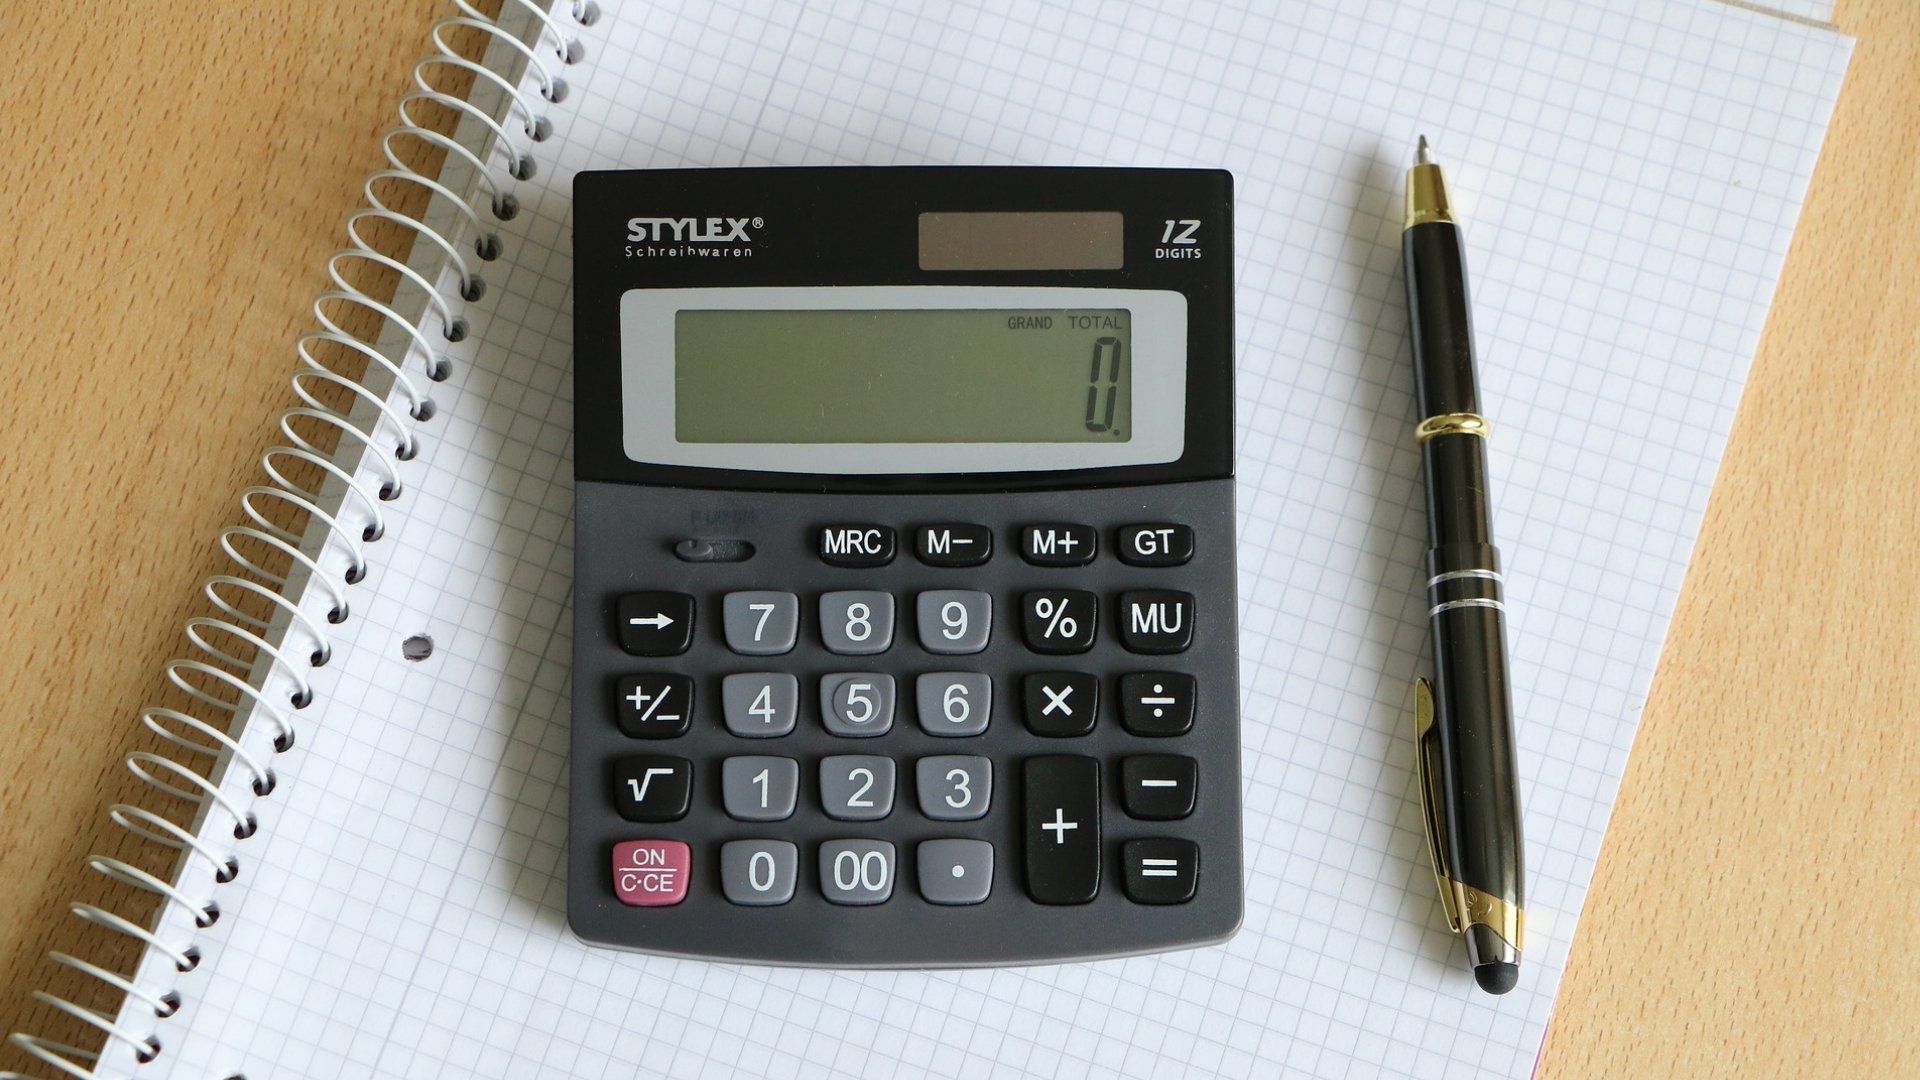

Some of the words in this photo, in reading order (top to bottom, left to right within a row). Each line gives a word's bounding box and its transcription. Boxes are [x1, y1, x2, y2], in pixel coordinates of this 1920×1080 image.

[1155, 248, 1201, 259] DIGITS
[1008, 316, 1053, 330] GRAND
[1069, 315, 1122, 330] TOTAL
[825, 529, 882, 554] MRC
[1033, 529, 1079, 555] M+
[1134, 528, 1175, 555] GT
[749, 604, 775, 641] 7
[845, 603, 872, 641] 8
[941, 602, 968, 640] 9
[1036, 597, 1078, 639] %
[1132, 602, 1182, 634] MU
[748, 685, 776, 723] 4
[847, 684, 873, 723] 5
[943, 684, 970, 723] 6
[752, 769, 769, 808] 1
[847, 769, 874, 807] 2
[945, 769, 972, 808] 3
[632, 848, 665, 866] ON
[748, 851, 776, 891] 0
[834, 851, 888, 892] 00
